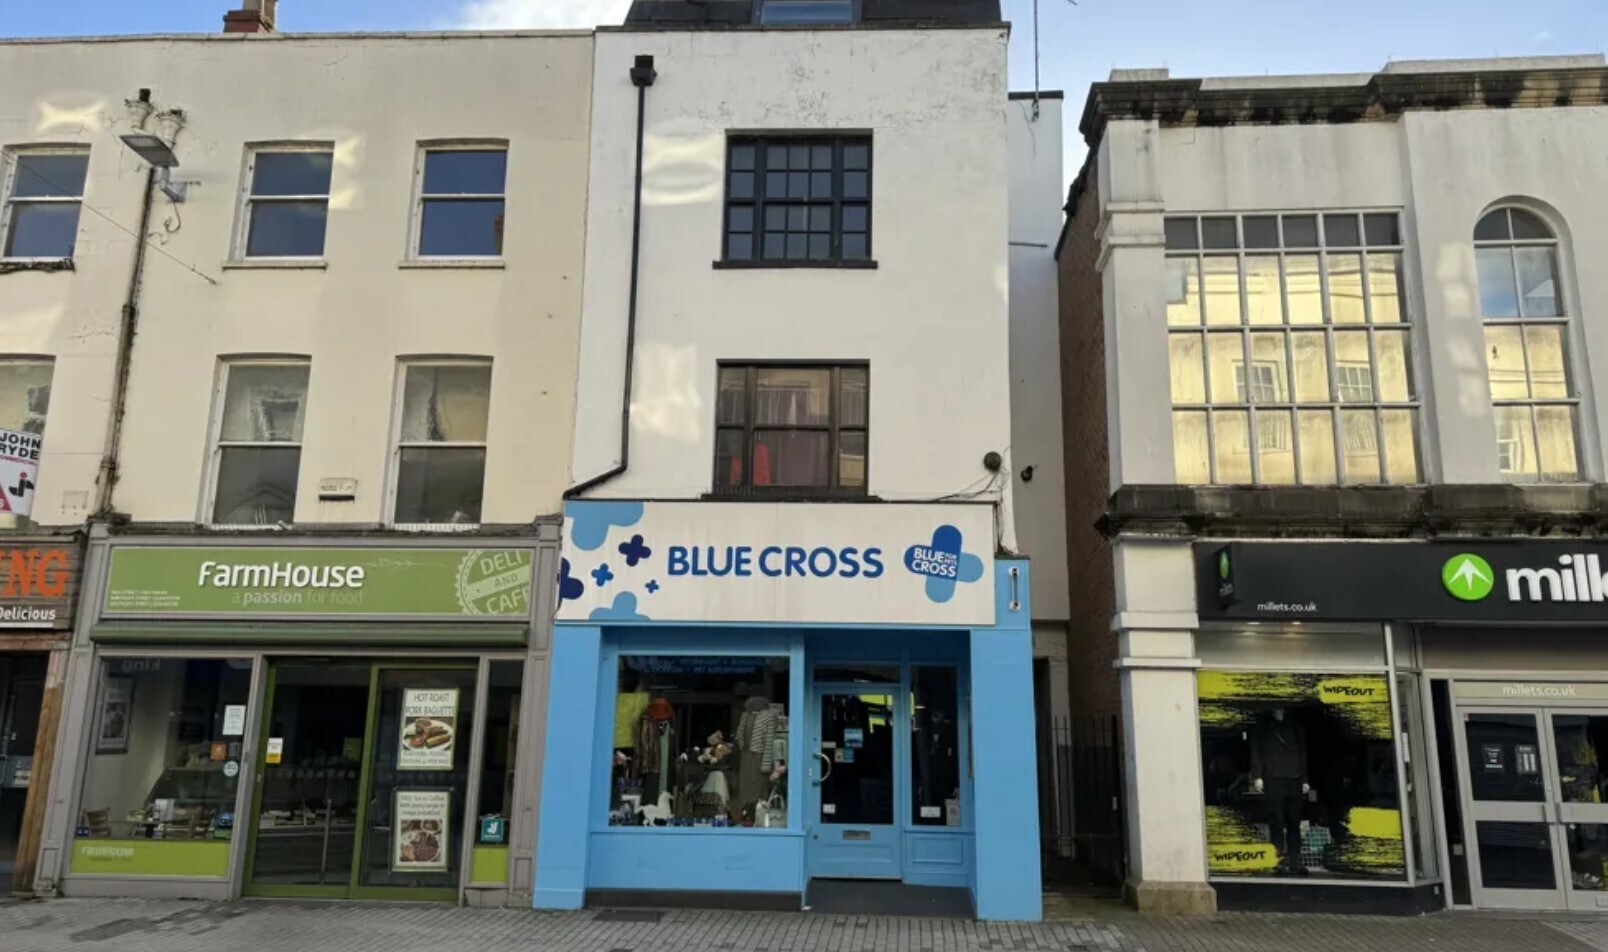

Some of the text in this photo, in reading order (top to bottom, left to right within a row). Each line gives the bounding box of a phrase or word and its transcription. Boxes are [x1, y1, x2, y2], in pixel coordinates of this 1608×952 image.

[0, 432, 41, 449] JOHN
[0, 443, 39, 460] RYDE
[481, 550, 522, 576] DELI
[667, 546, 885, 578] BLUE CROSS
[913, 547, 944, 563] BLUE
[0, 549, 69, 597] NG
[198, 561, 365, 588] FarmHouse
[911, 559, 956, 577] CROSS
[495, 572, 519, 588] AND
[1506, 554, 1608, 602] mill
[231, 588, 363, 608] a passion for food
[1257, 601, 1318, 612] millets.co.uk
[413, 692, 428, 702] HOT
[1323, 685, 1375, 696] WIPEOUT
[1503, 684, 1577, 697] millets.co.uk
[1215, 851, 1266, 862] WIPEOUT
